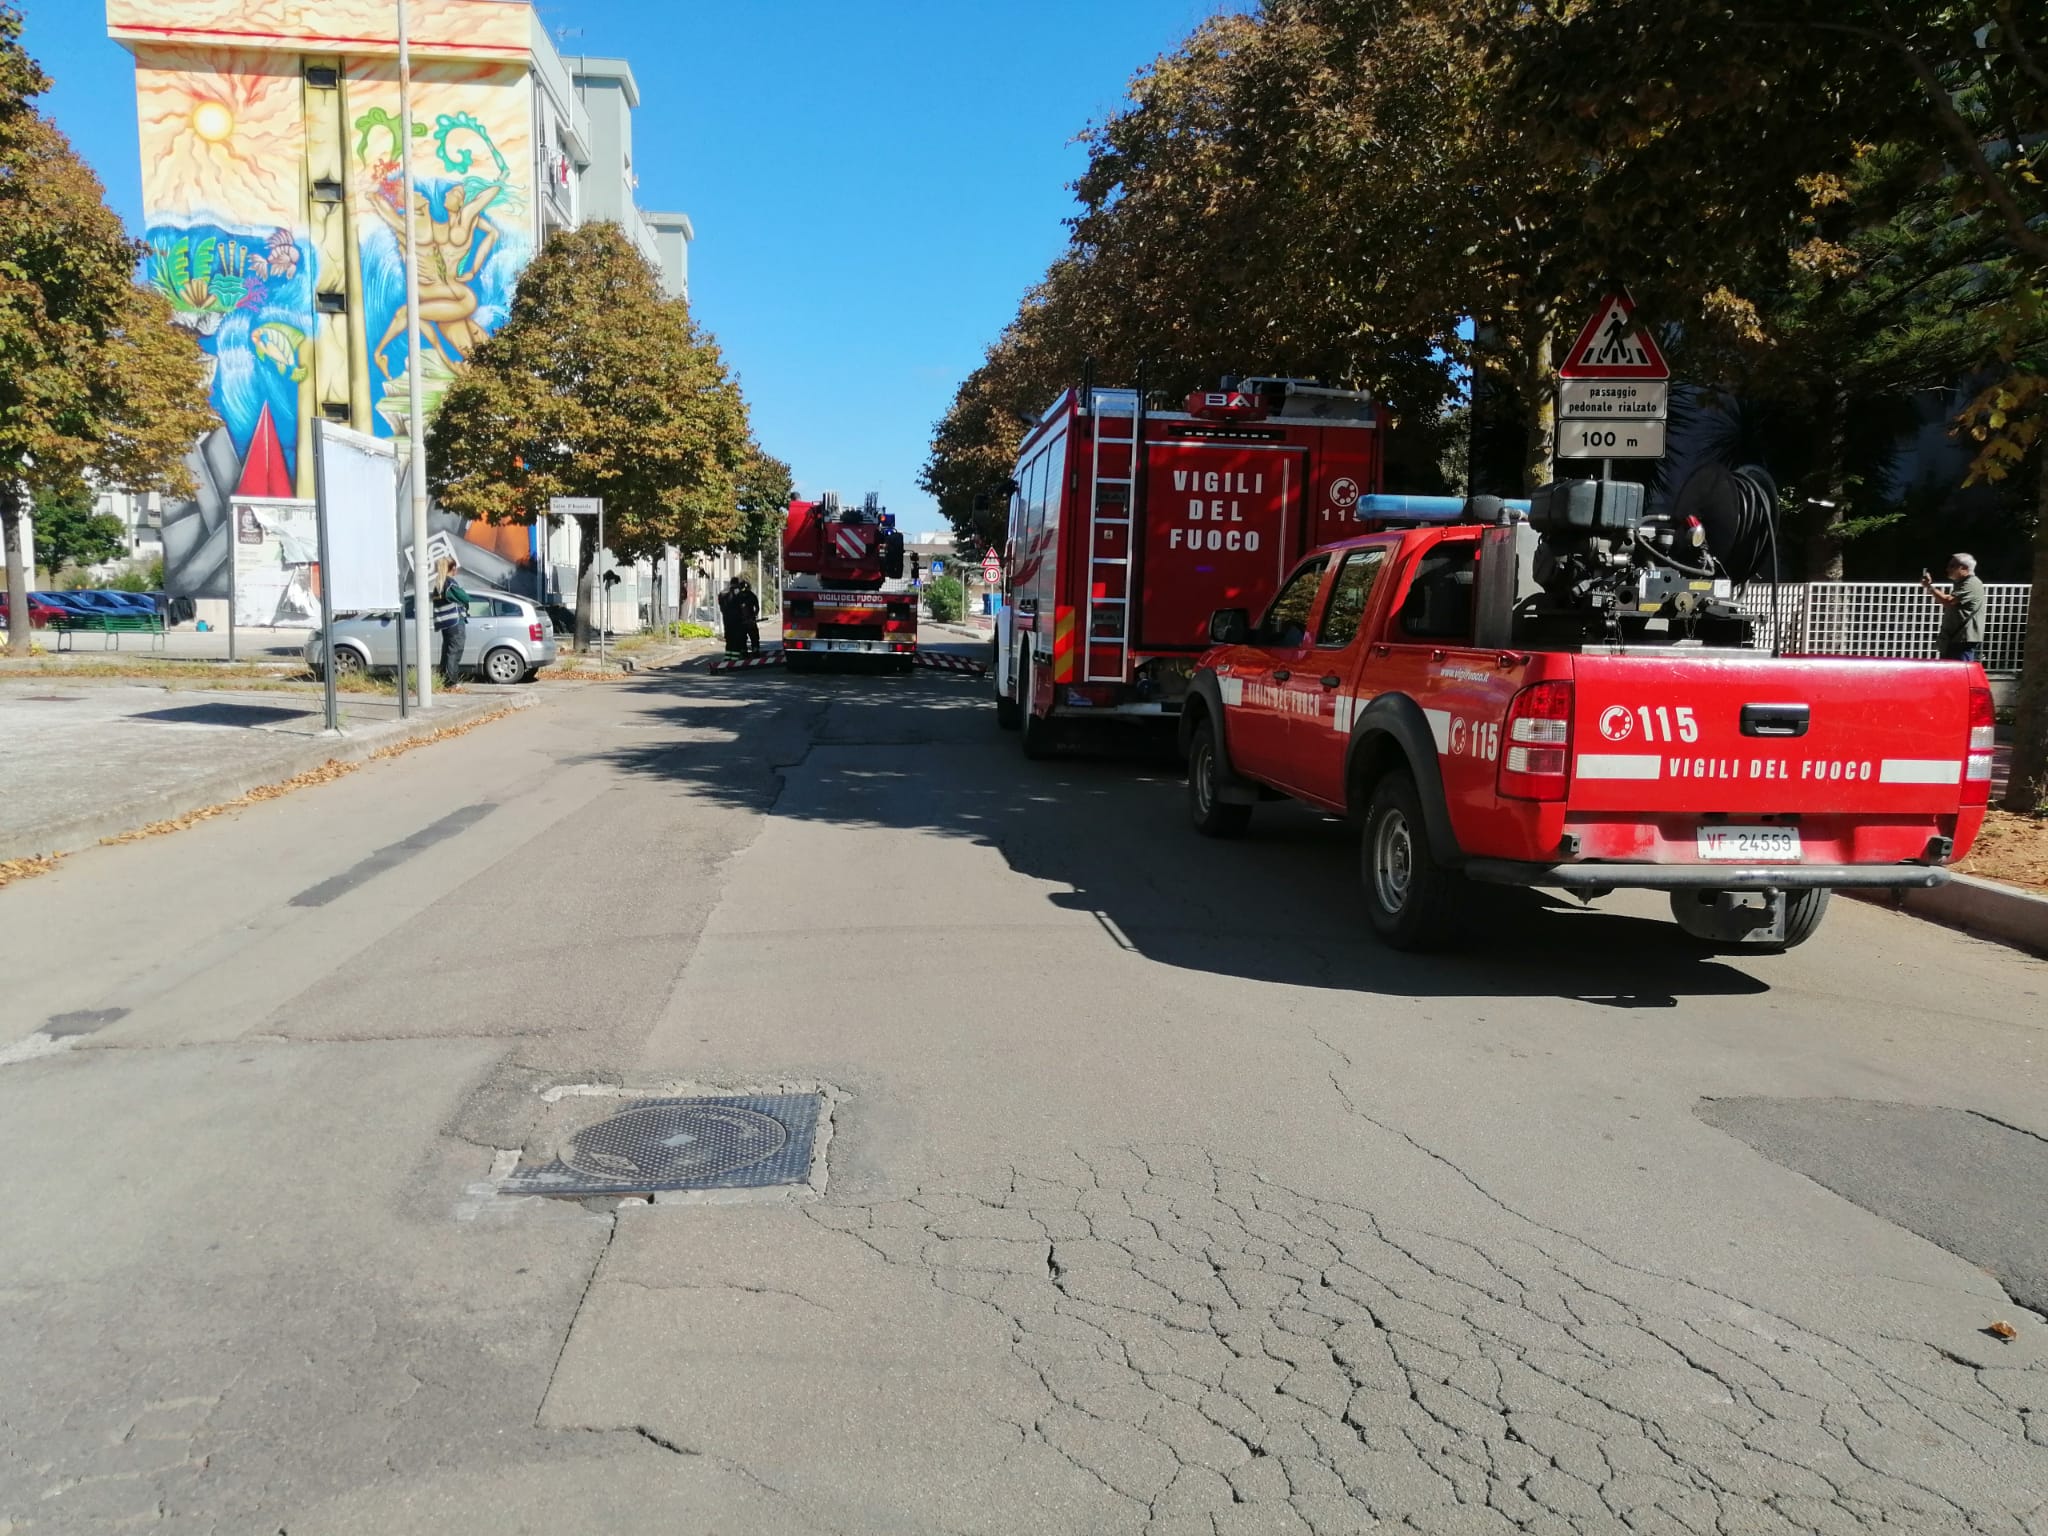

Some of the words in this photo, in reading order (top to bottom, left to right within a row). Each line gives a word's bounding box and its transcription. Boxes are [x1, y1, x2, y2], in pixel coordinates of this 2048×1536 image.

[1205, 393, 1259, 408] BAI
[1590, 386, 1637, 399] passaggio
[1569, 401, 1613, 413] pedonale
[1618, 401, 1657, 412] rialzato
[1582, 431, 1616, 447] 100
[1626, 438, 1638, 447] m
[1173, 470, 1263, 494] VIGILI
[1189, 499, 1243, 521] DEL
[1169, 528, 1260, 551] FUOCO
[818, 593, 841, 601] VIGILI
[841, 593, 855, 601] DEL
[1638, 705, 1698, 743] 115
[1471, 721, 1499, 761] 115
[1669, 758, 1739, 779] VIGILI
[1749, 759, 1788, 779] DEL
[1801, 760, 1871, 780] FUOCO
[1707, 833, 1727, 850] VF
[1738, 832, 1792, 851] 24559
